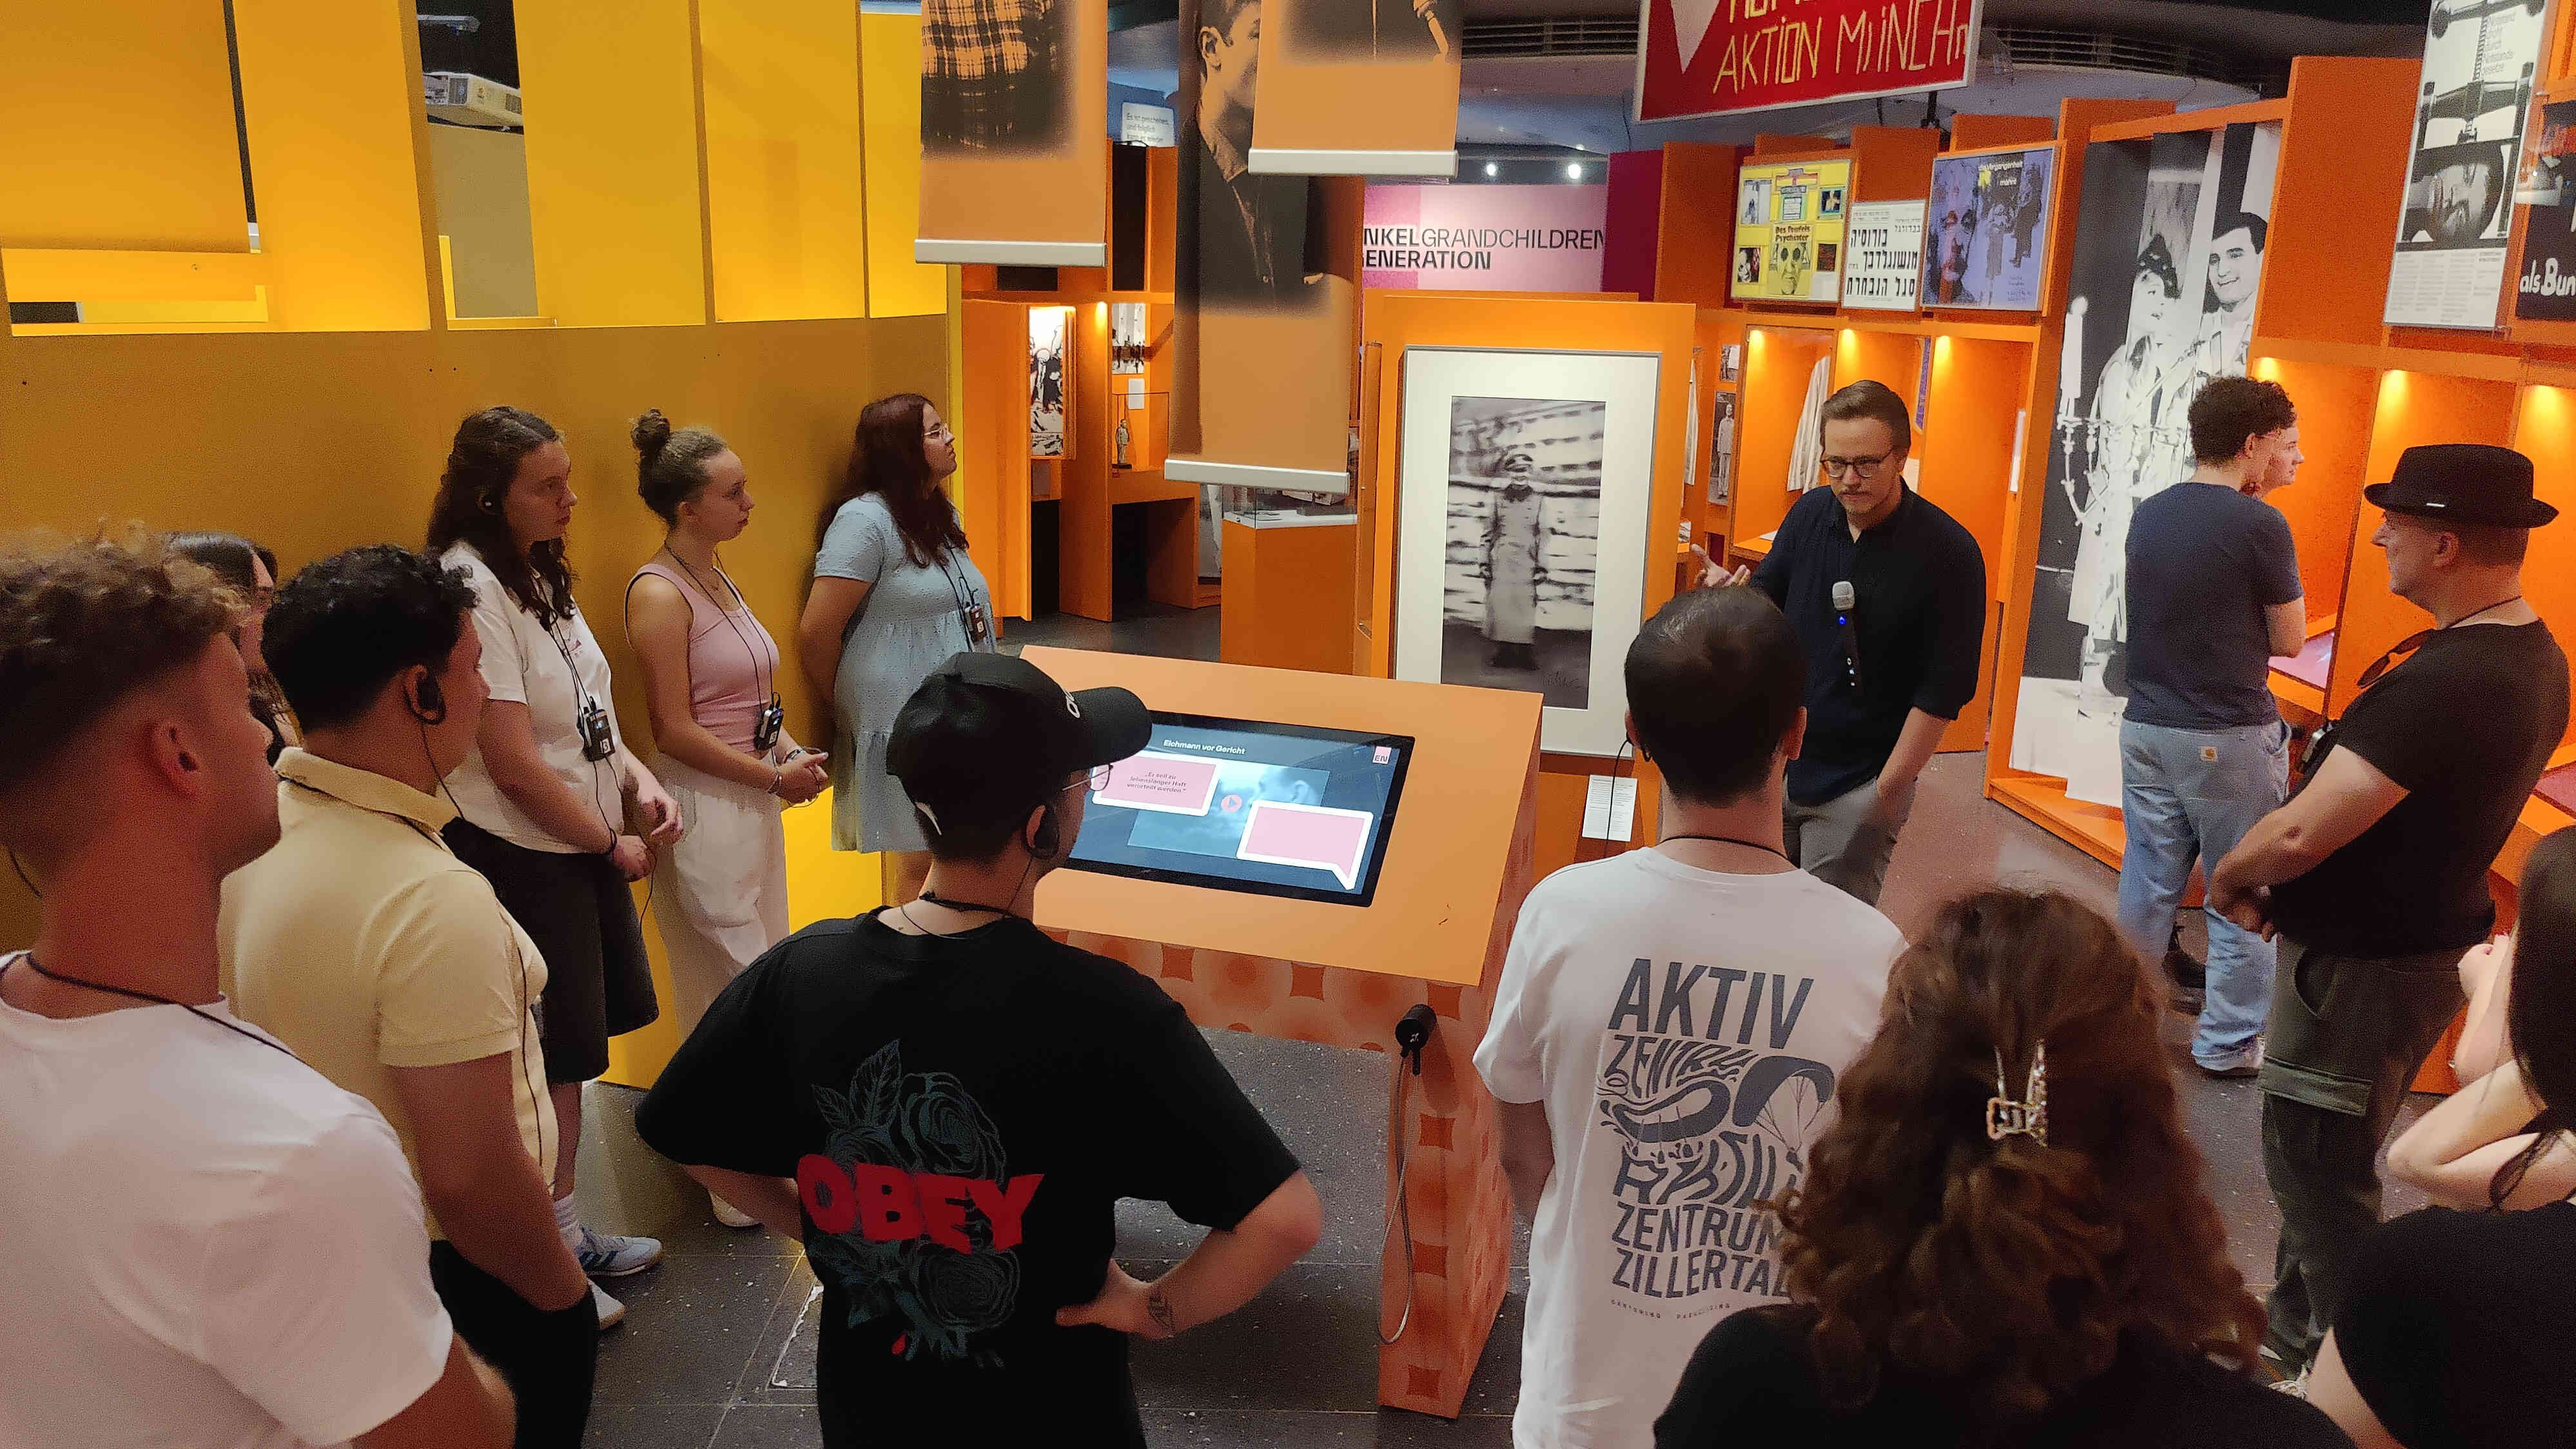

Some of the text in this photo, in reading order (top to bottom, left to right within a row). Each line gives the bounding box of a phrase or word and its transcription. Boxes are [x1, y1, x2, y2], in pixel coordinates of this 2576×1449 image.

[1850, 229, 1888, 248] בורוסיה
[1362, 250, 1491, 270] ENERATION
[2519, 259, 2541, 294] als
[1163, 739, 1201, 751] Eichmann
[1215, 745, 1245, 755] Gericht
[1608, 958, 1815, 1050] AKTIV
[796, 1154, 1045, 1254] OBEY
